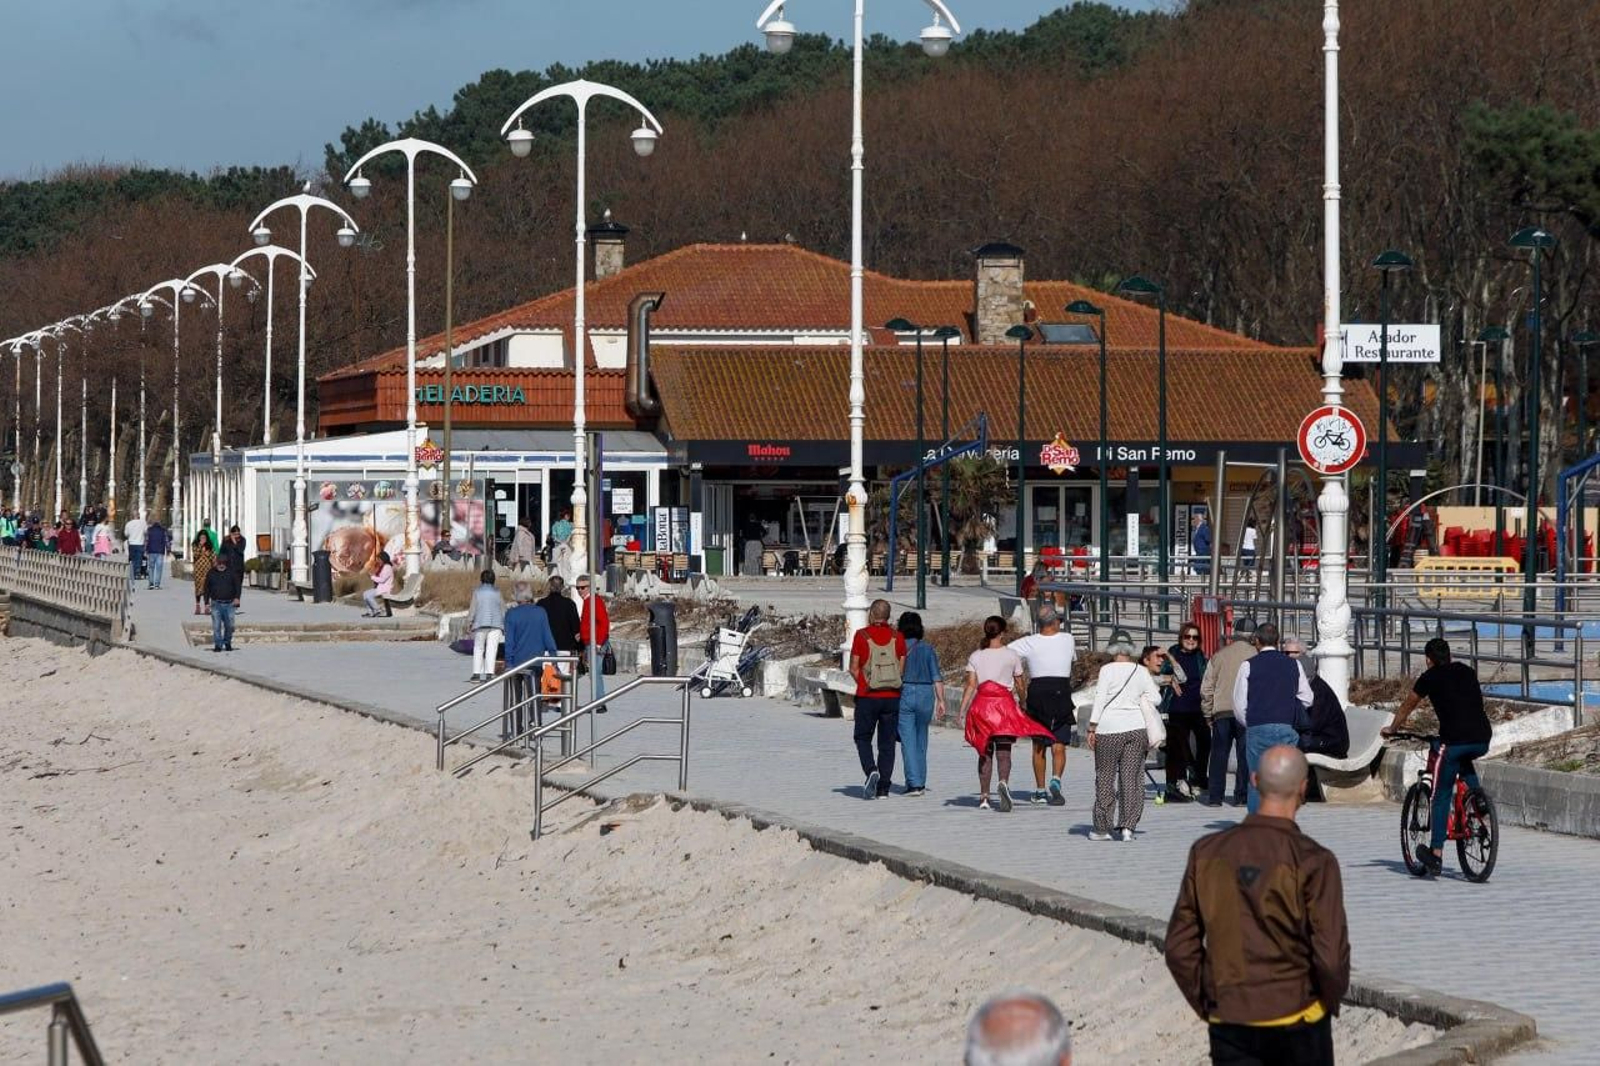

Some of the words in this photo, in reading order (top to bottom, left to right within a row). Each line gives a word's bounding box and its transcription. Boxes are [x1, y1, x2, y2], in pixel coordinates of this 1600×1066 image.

[1368, 329, 1417, 343] Aador
[748, 443, 791, 456] Mahou
[1053, 445, 1078, 456] San
[1117, 446, 1147, 461] San
[1041, 452, 1080, 465] Remo
